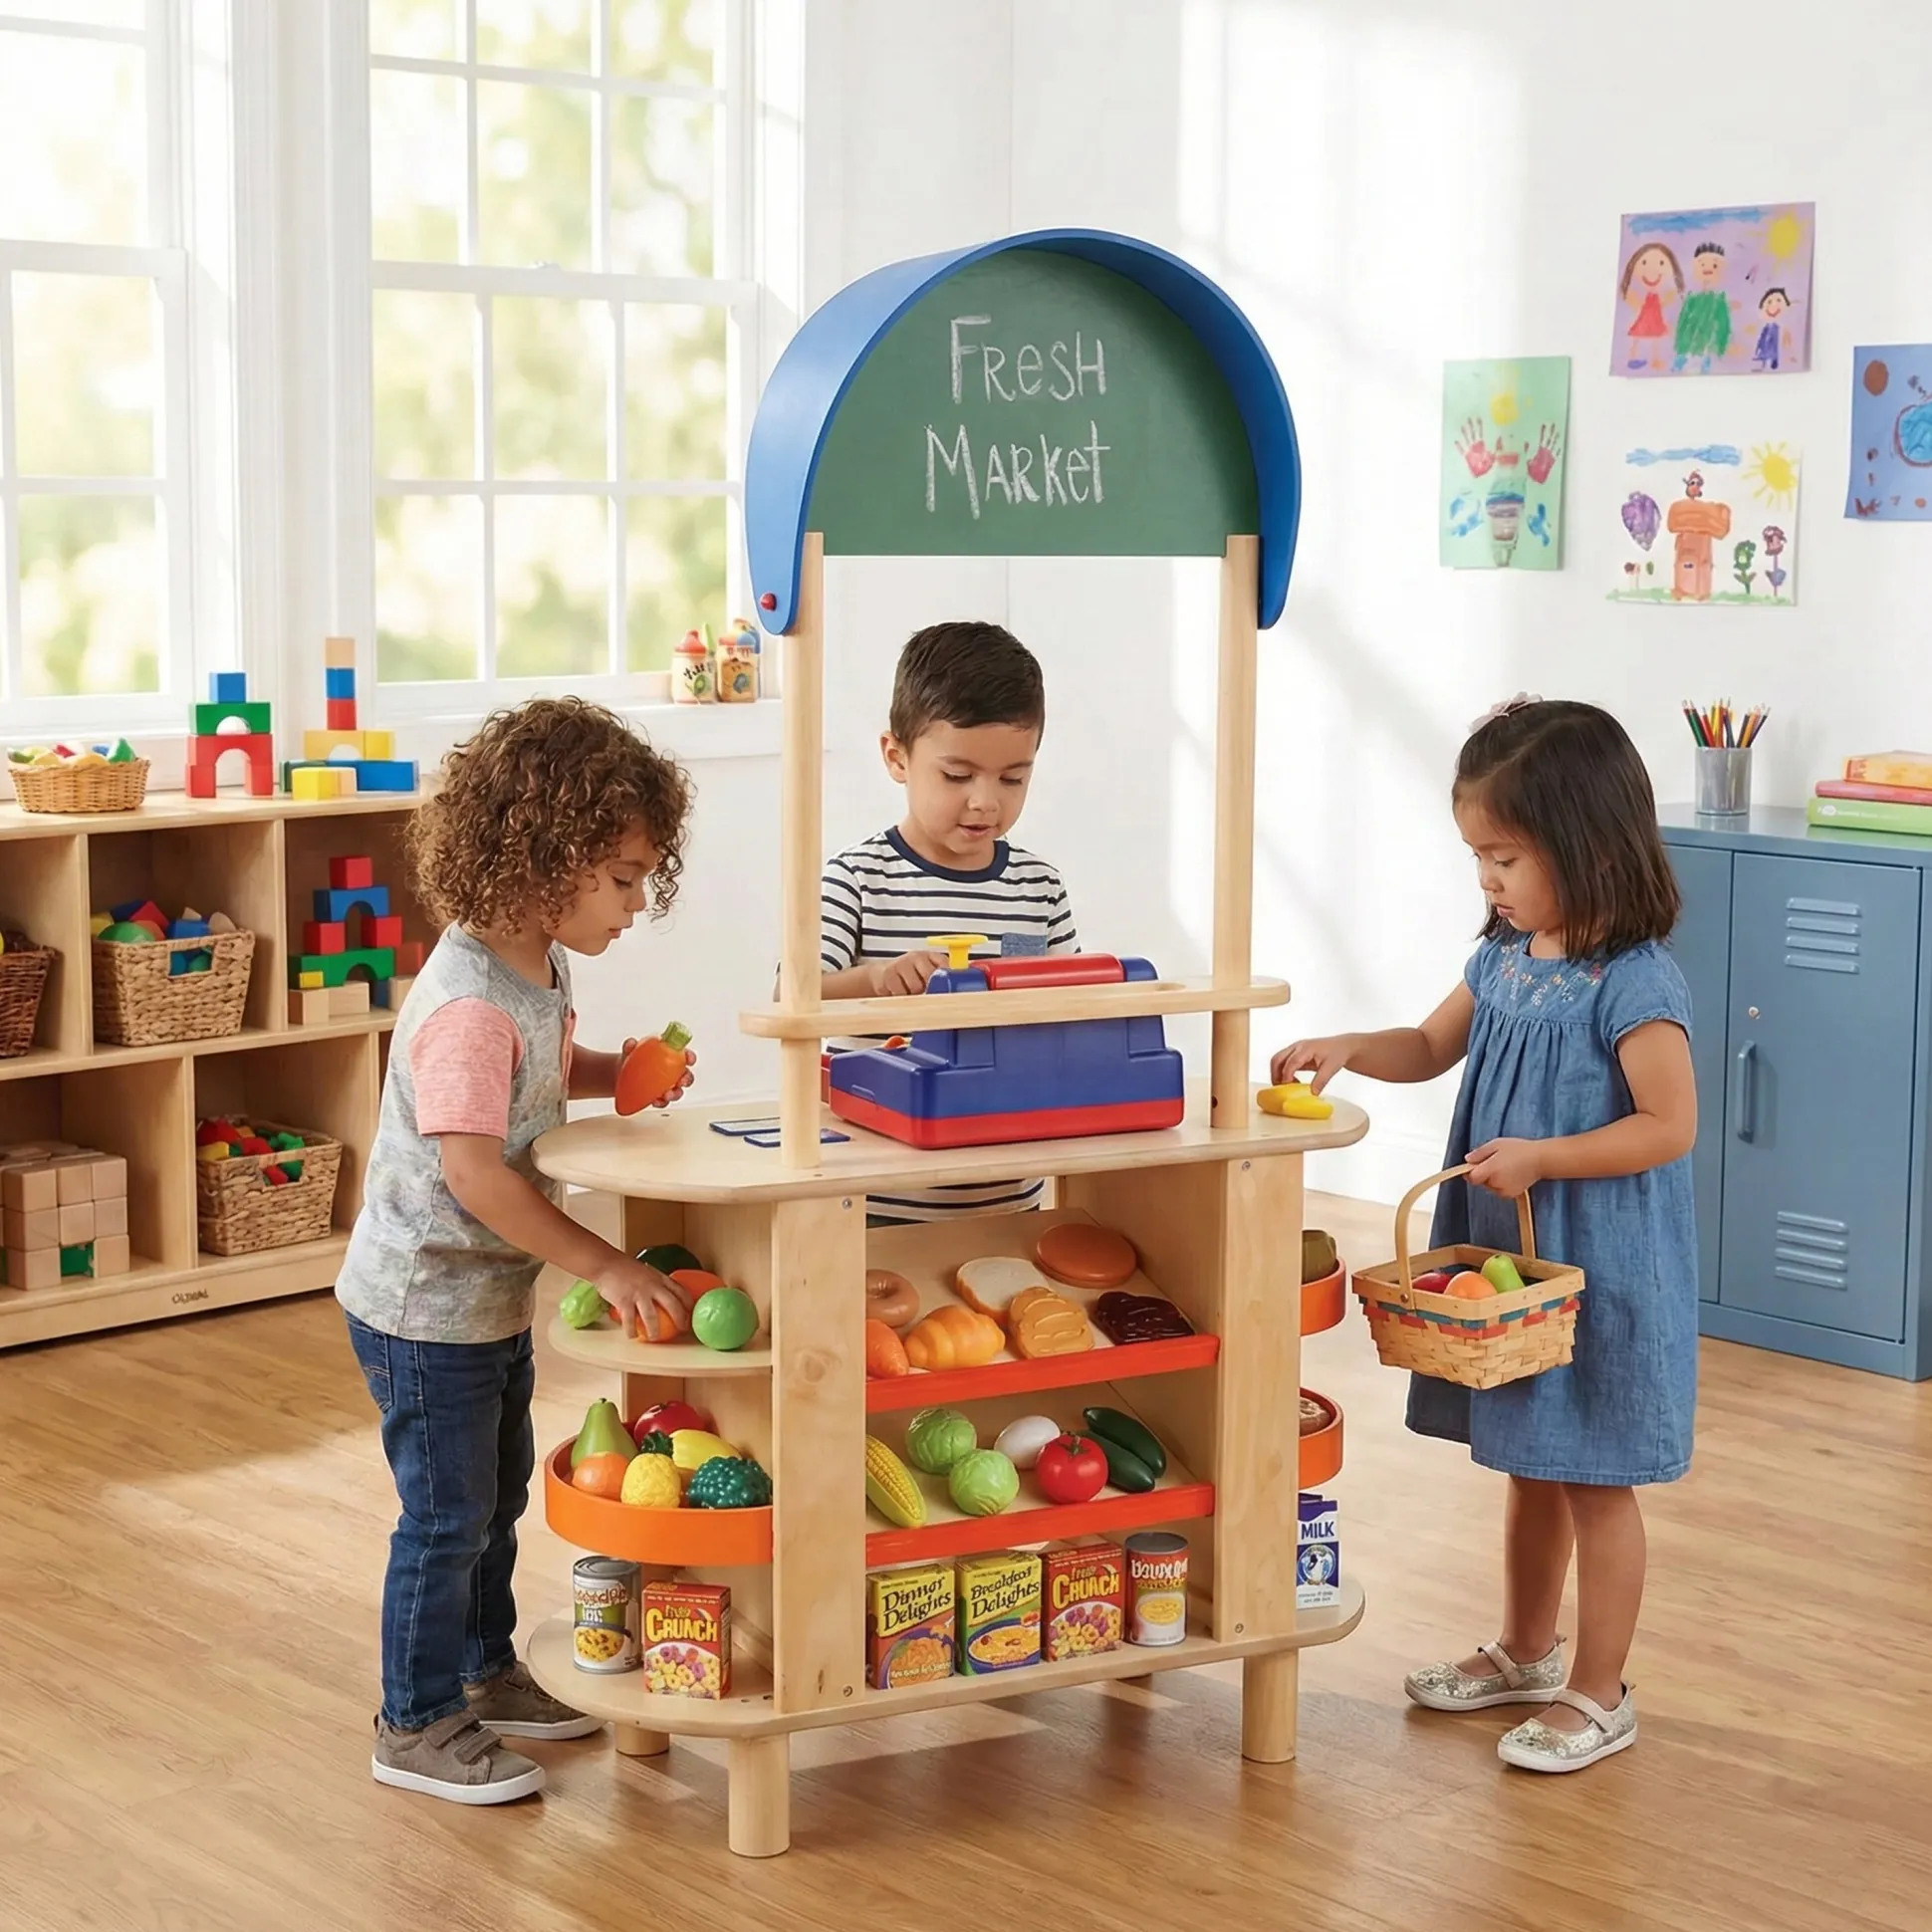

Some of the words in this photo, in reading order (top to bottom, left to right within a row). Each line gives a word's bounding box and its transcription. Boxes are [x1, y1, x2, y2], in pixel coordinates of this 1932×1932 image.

[1301, 1521, 1334, 1540] MILK
[972, 1581, 1039, 1619] Delights
[646, 1608, 718, 1642] CRUNCH
